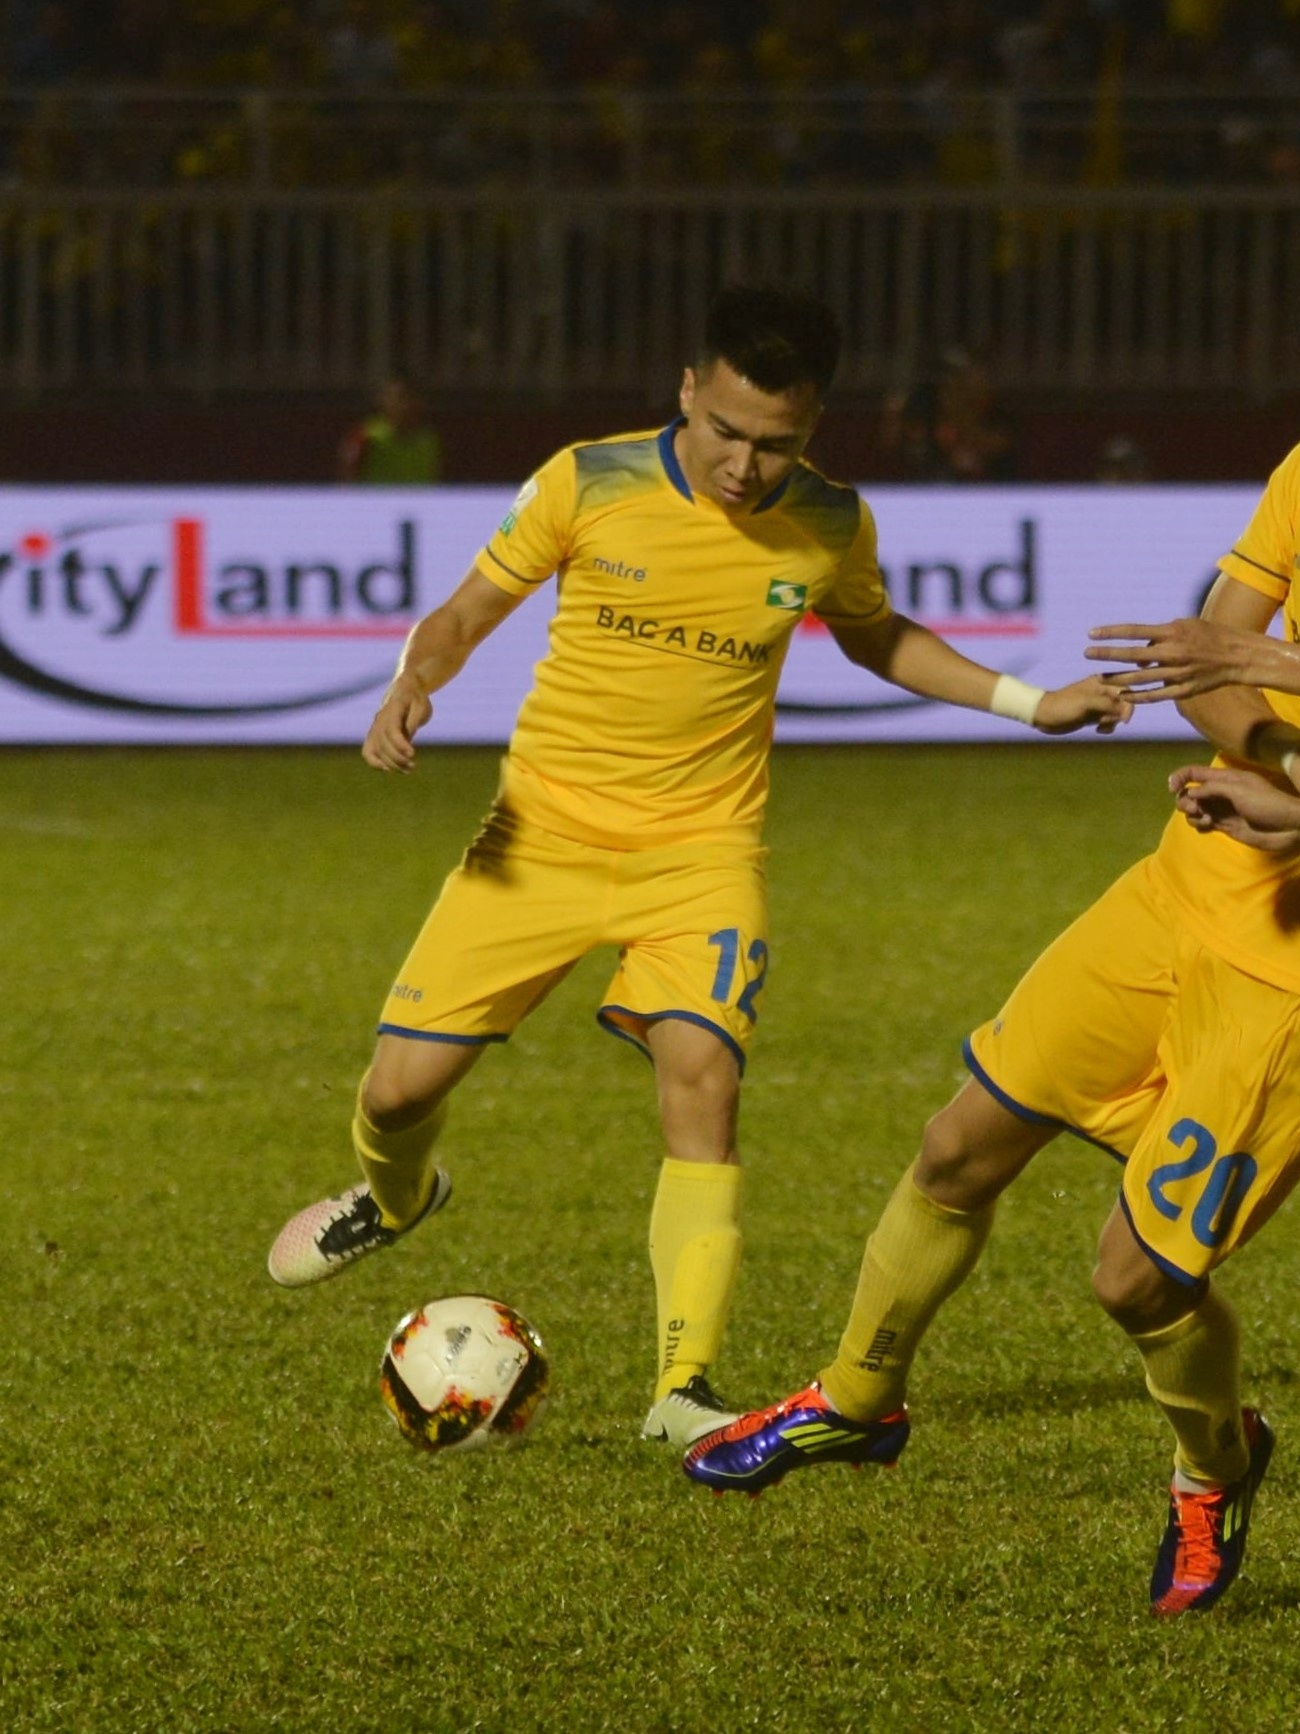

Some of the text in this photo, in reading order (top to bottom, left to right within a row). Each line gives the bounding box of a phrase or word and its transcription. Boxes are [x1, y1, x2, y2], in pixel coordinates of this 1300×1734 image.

[0, 516, 418, 638] ityLand
[593, 557, 647, 583] mitre
[596, 604, 774, 663] BAC A BANK
[707, 928, 769, 1027] 12
[1146, 1117, 1258, 1248] 20
